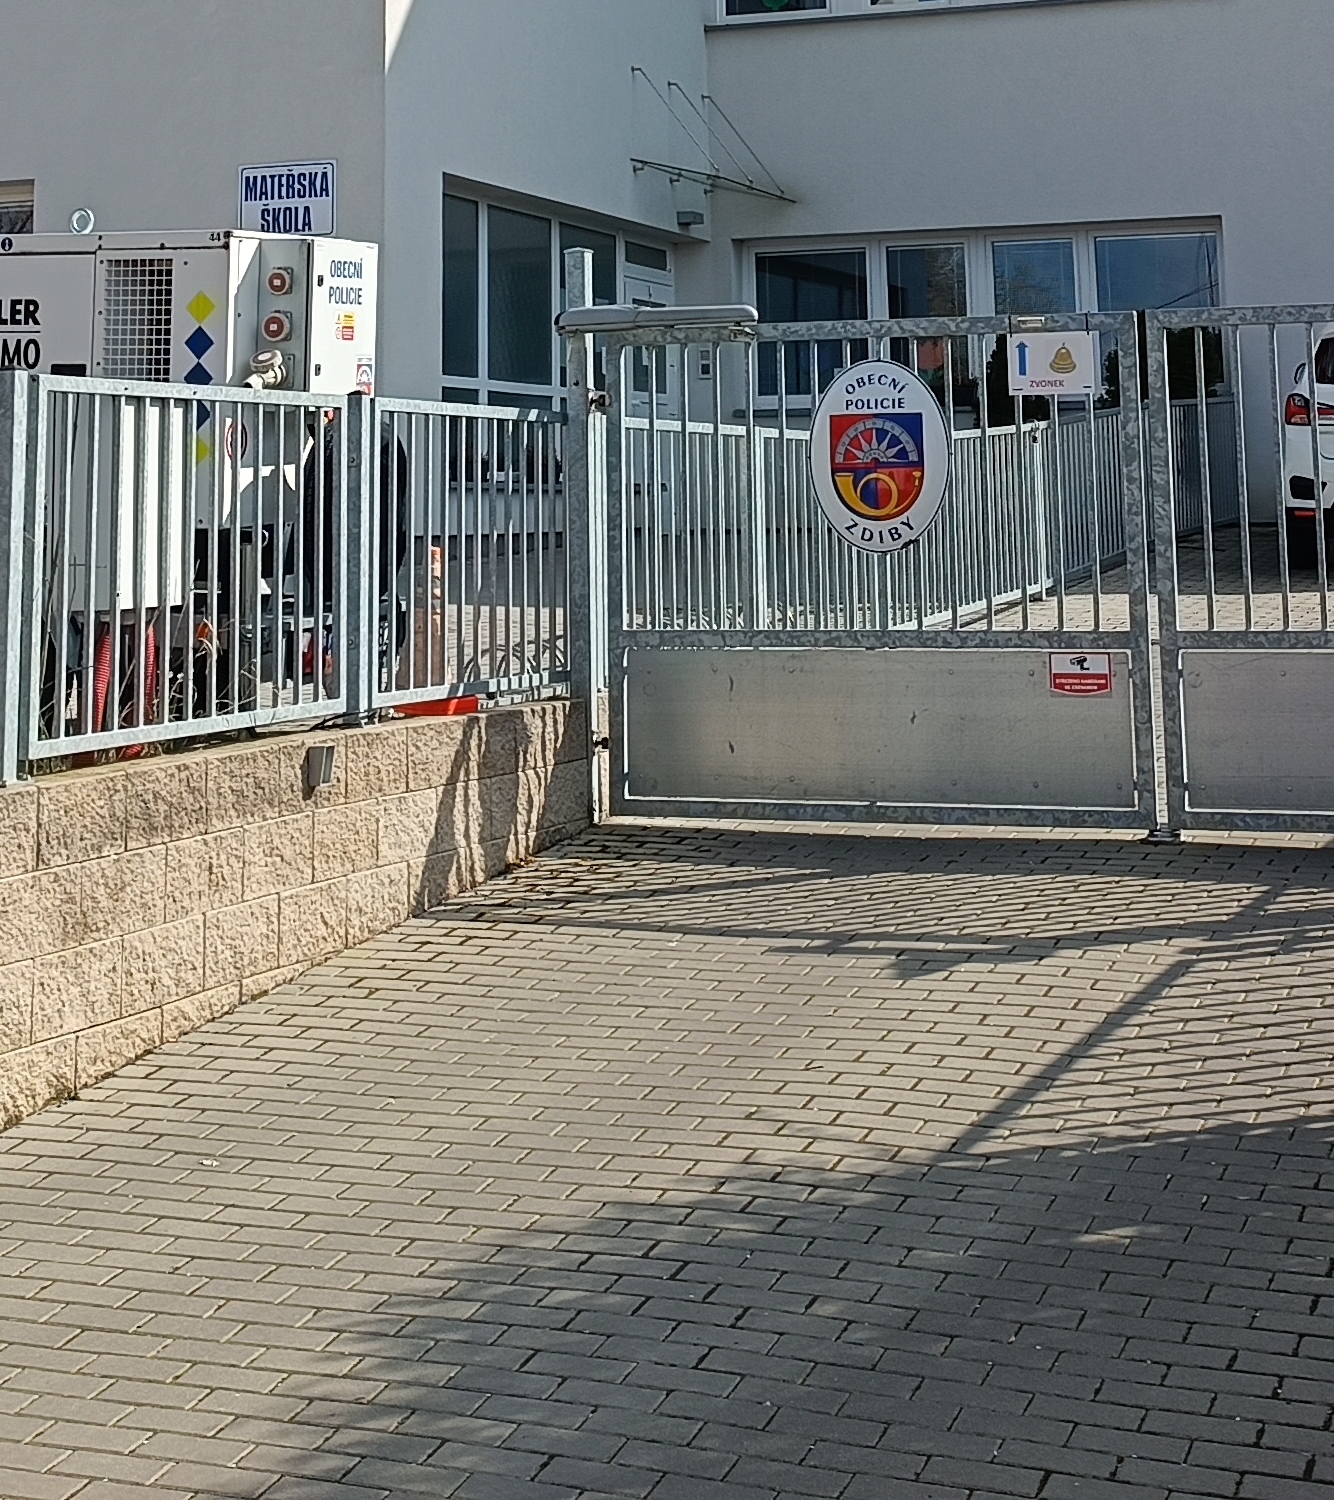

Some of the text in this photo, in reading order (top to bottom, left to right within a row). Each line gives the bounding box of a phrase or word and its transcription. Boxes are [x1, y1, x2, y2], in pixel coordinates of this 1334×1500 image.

[244, 167, 330, 202] MATEŘSKÁ
[260, 203, 313, 234] ŠKOLA
[329, 257, 363, 280] OBECNÍ
[328, 285, 363, 306] POLICIE
[845, 373, 910, 395] OBECNÍ
[1029, 379, 1065, 388] ZVONEK
[845, 397, 907, 411] POLICIE
[845, 515, 915, 544] ZDIBY
